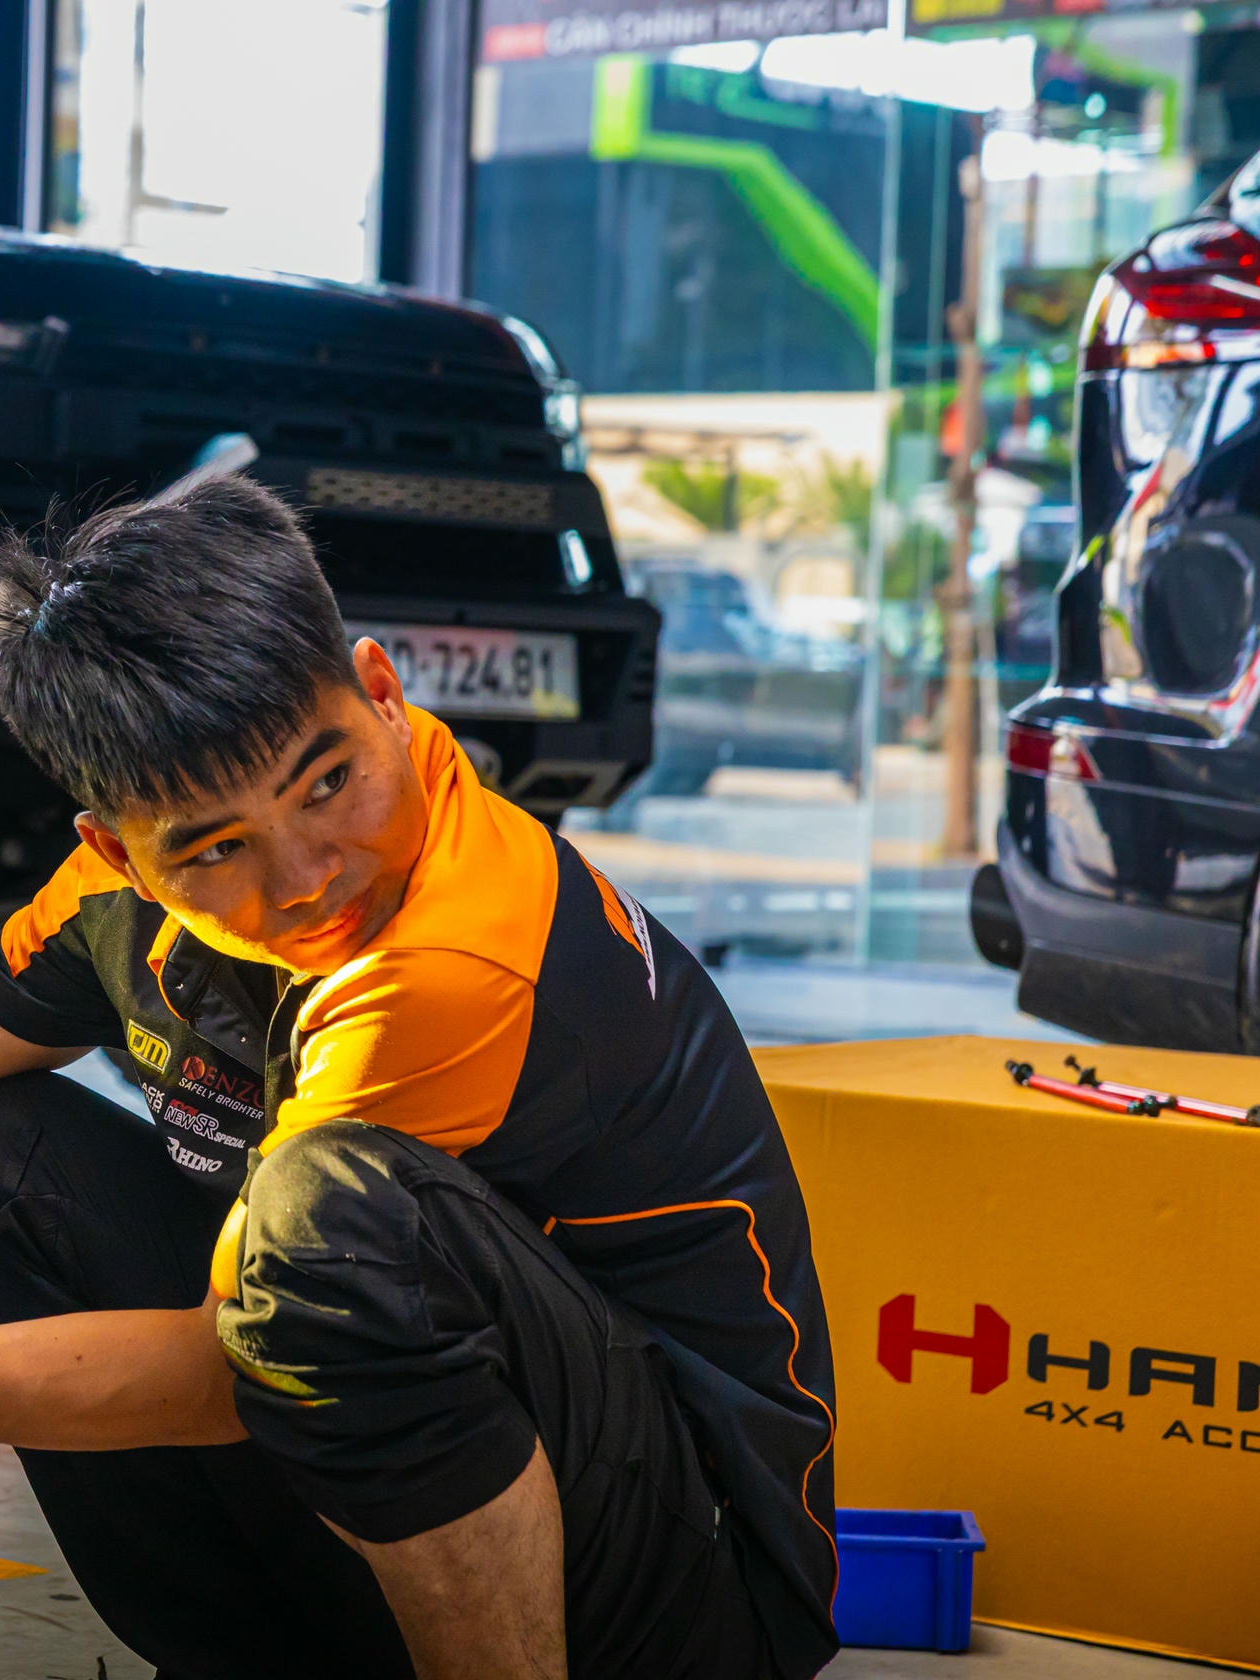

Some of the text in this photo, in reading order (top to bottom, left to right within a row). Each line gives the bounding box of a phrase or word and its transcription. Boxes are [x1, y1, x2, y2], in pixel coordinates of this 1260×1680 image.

[346, 636, 556, 700] D-724.81
[178, 1077, 216, 1099] SAFELY
[215, 1094, 265, 1120] BRIGHTER
[166, 1136, 223, 1173] RHINO
[1027, 1333, 1260, 1412] HA
